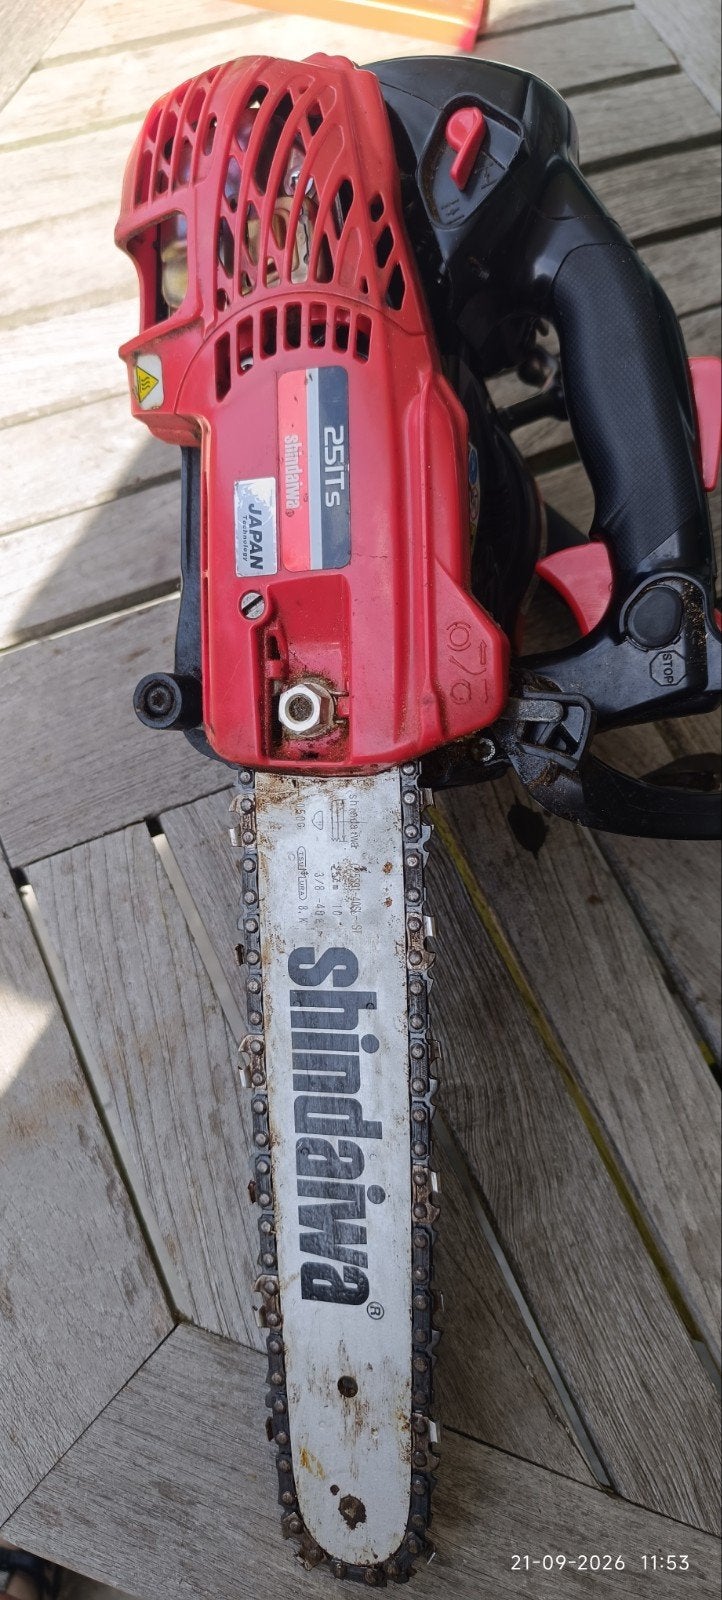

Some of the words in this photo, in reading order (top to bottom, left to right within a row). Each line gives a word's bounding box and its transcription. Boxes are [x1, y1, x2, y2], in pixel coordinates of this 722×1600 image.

[284, 434, 302, 509] shindaiwa
[249, 503, 264, 570] JAPAN
[663, 653, 674, 684] STOP
[288, 946, 386, 1305] shindaiwa
